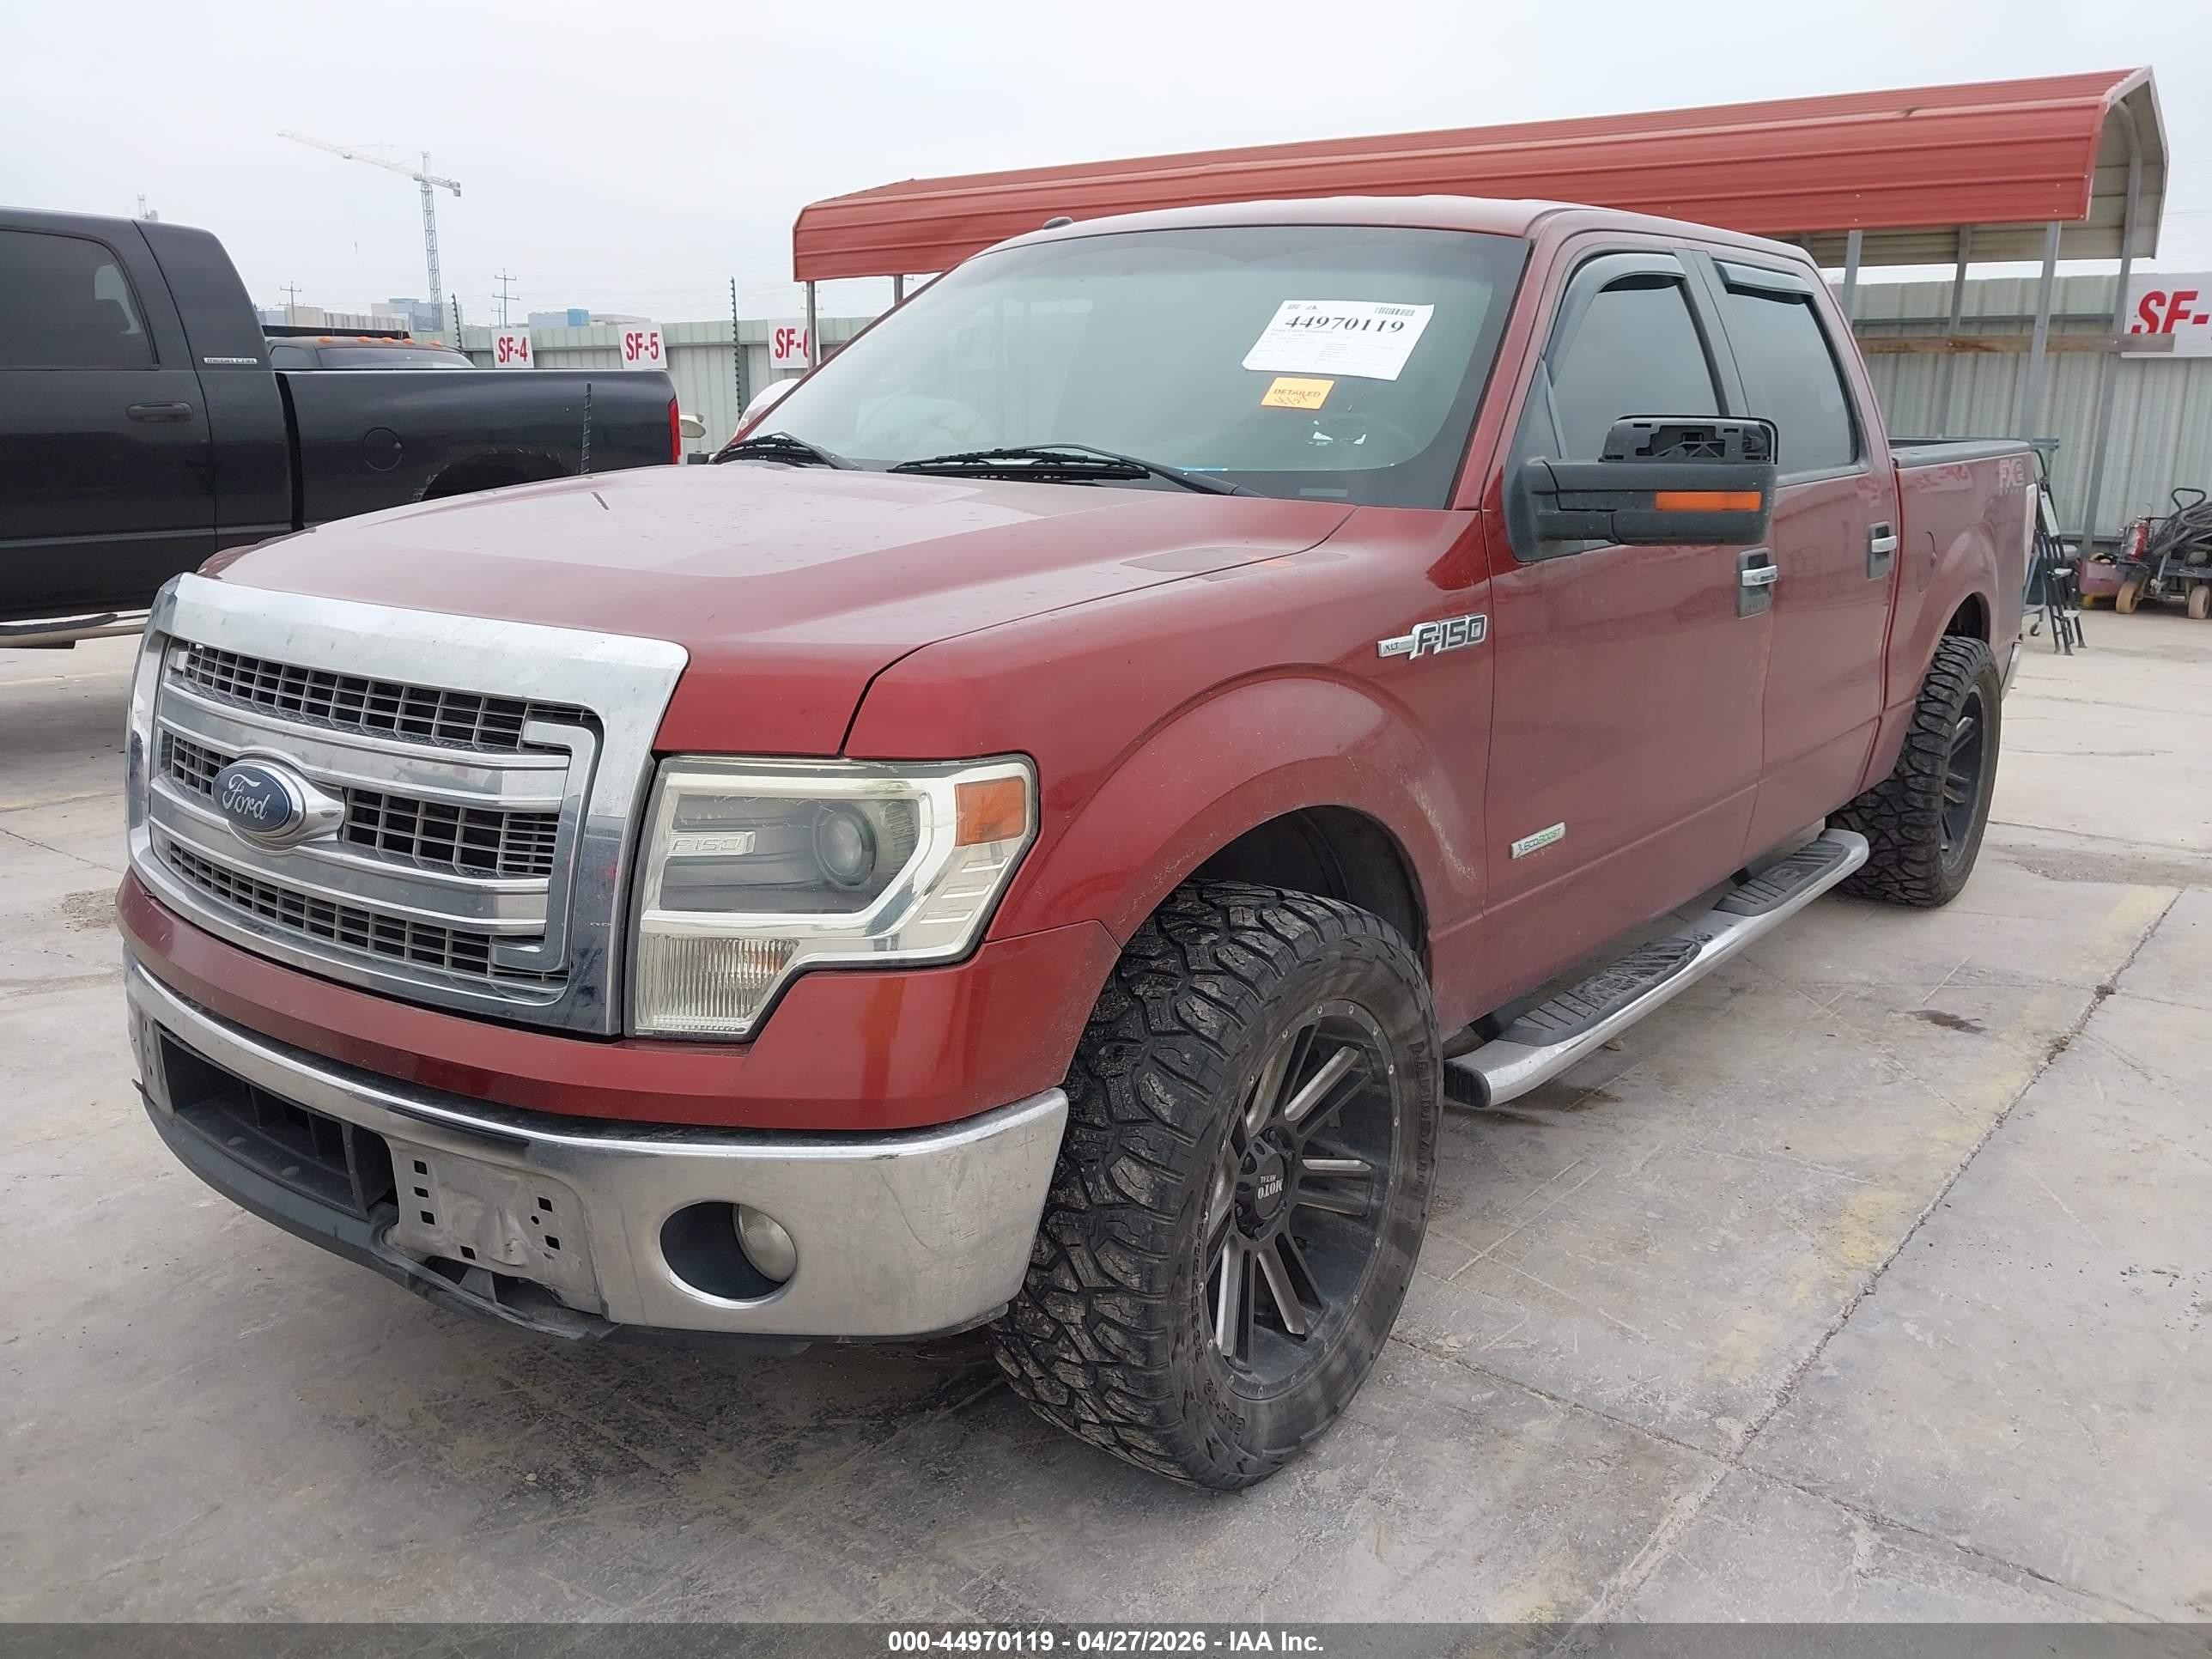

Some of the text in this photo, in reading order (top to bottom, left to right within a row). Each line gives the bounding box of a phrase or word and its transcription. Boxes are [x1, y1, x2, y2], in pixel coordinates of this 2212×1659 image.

[1285, 314, 1405, 333] 44970119
[498, 336, 528, 363] SF-4
[625, 331, 659, 361] SF-5
[1273, 388, 1322, 398] DETAILED
[222, 774, 271, 820] Ford
[1257, 1178, 1285, 1200] MOTO
